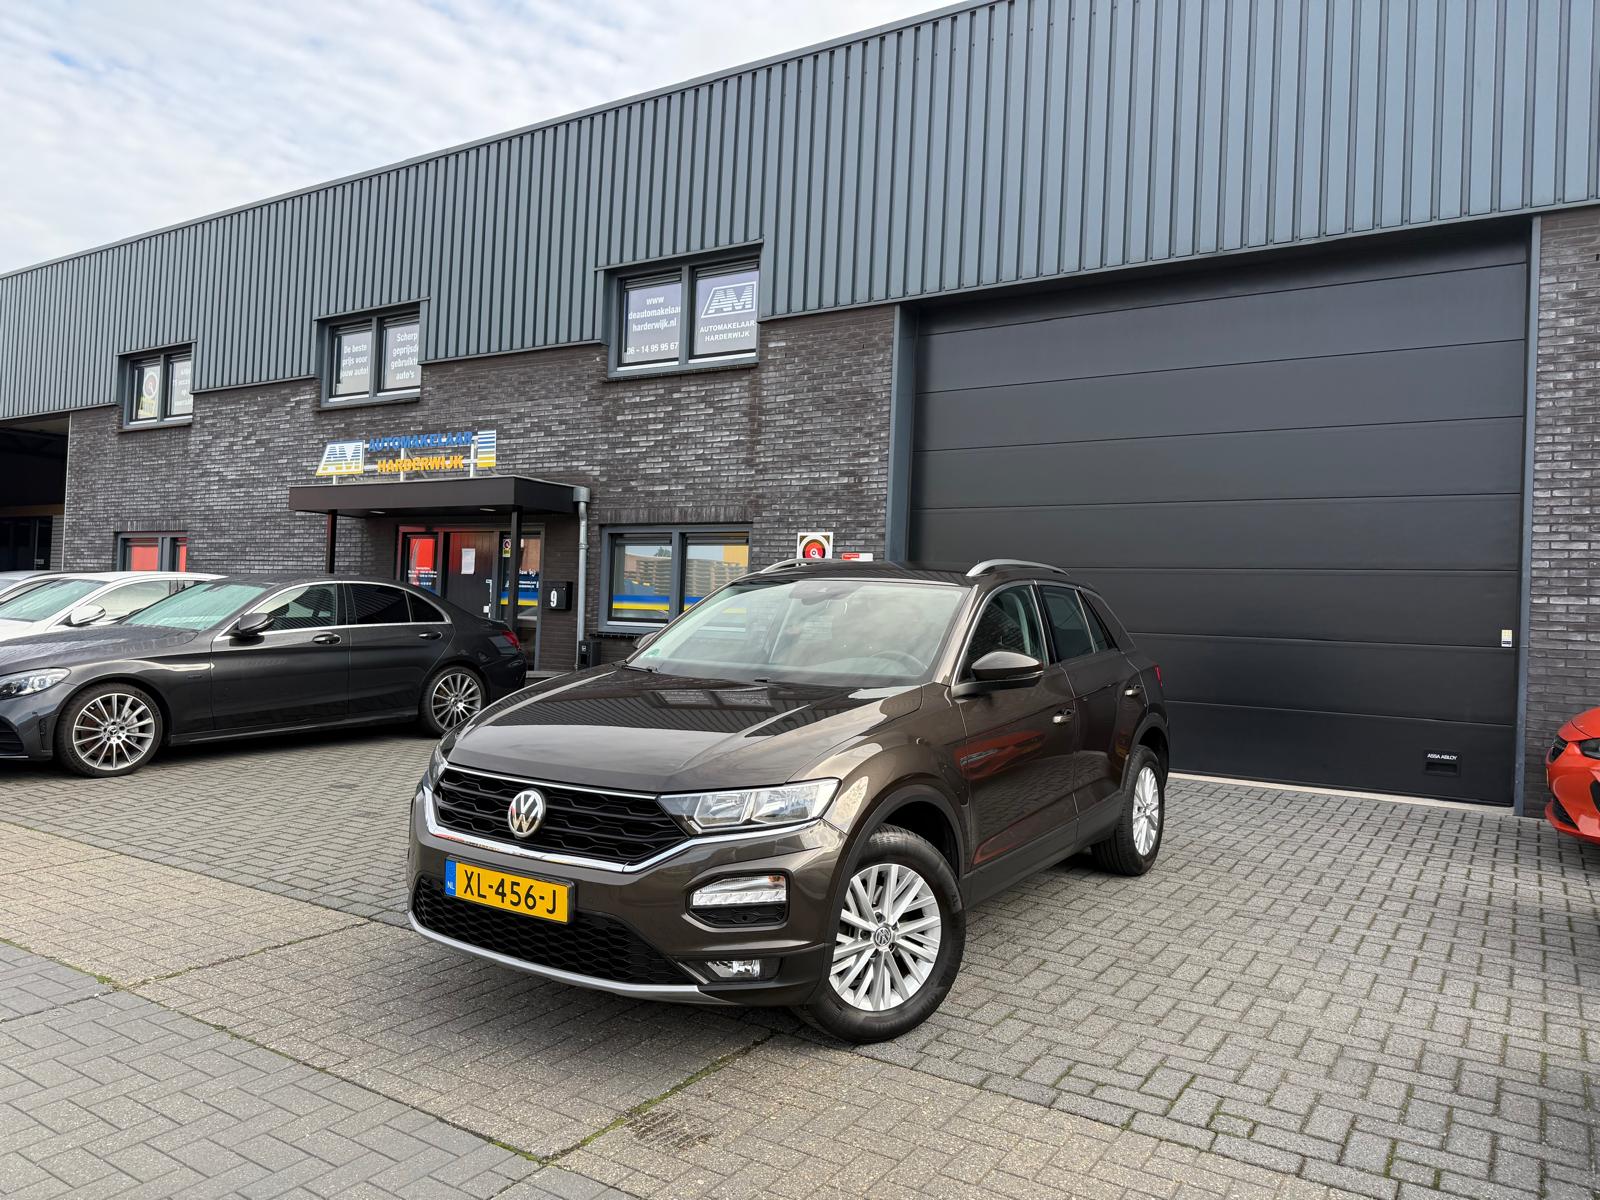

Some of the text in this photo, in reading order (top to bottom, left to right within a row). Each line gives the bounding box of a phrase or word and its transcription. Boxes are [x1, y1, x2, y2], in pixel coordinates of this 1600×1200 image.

[646, 296, 665, 305] www
[632, 317, 677, 332] harderwijk.nl
[700, 319, 755, 333] AUTOMAKELAAR
[397, 332, 418, 342] Scherp
[705, 330, 751, 342] HARDERWIJK
[641, 344, 649, 353] 14
[670, 341, 679, 350] 67
[396, 370, 415, 380] auto's
[368, 431, 473, 452] AUTOMAKELAAR
[377, 455, 464, 473] HARDERWIJK
[550, 590, 558, 607] 9
[447, 881, 455, 890] NL
[463, 869, 557, 915] XL-456-J
